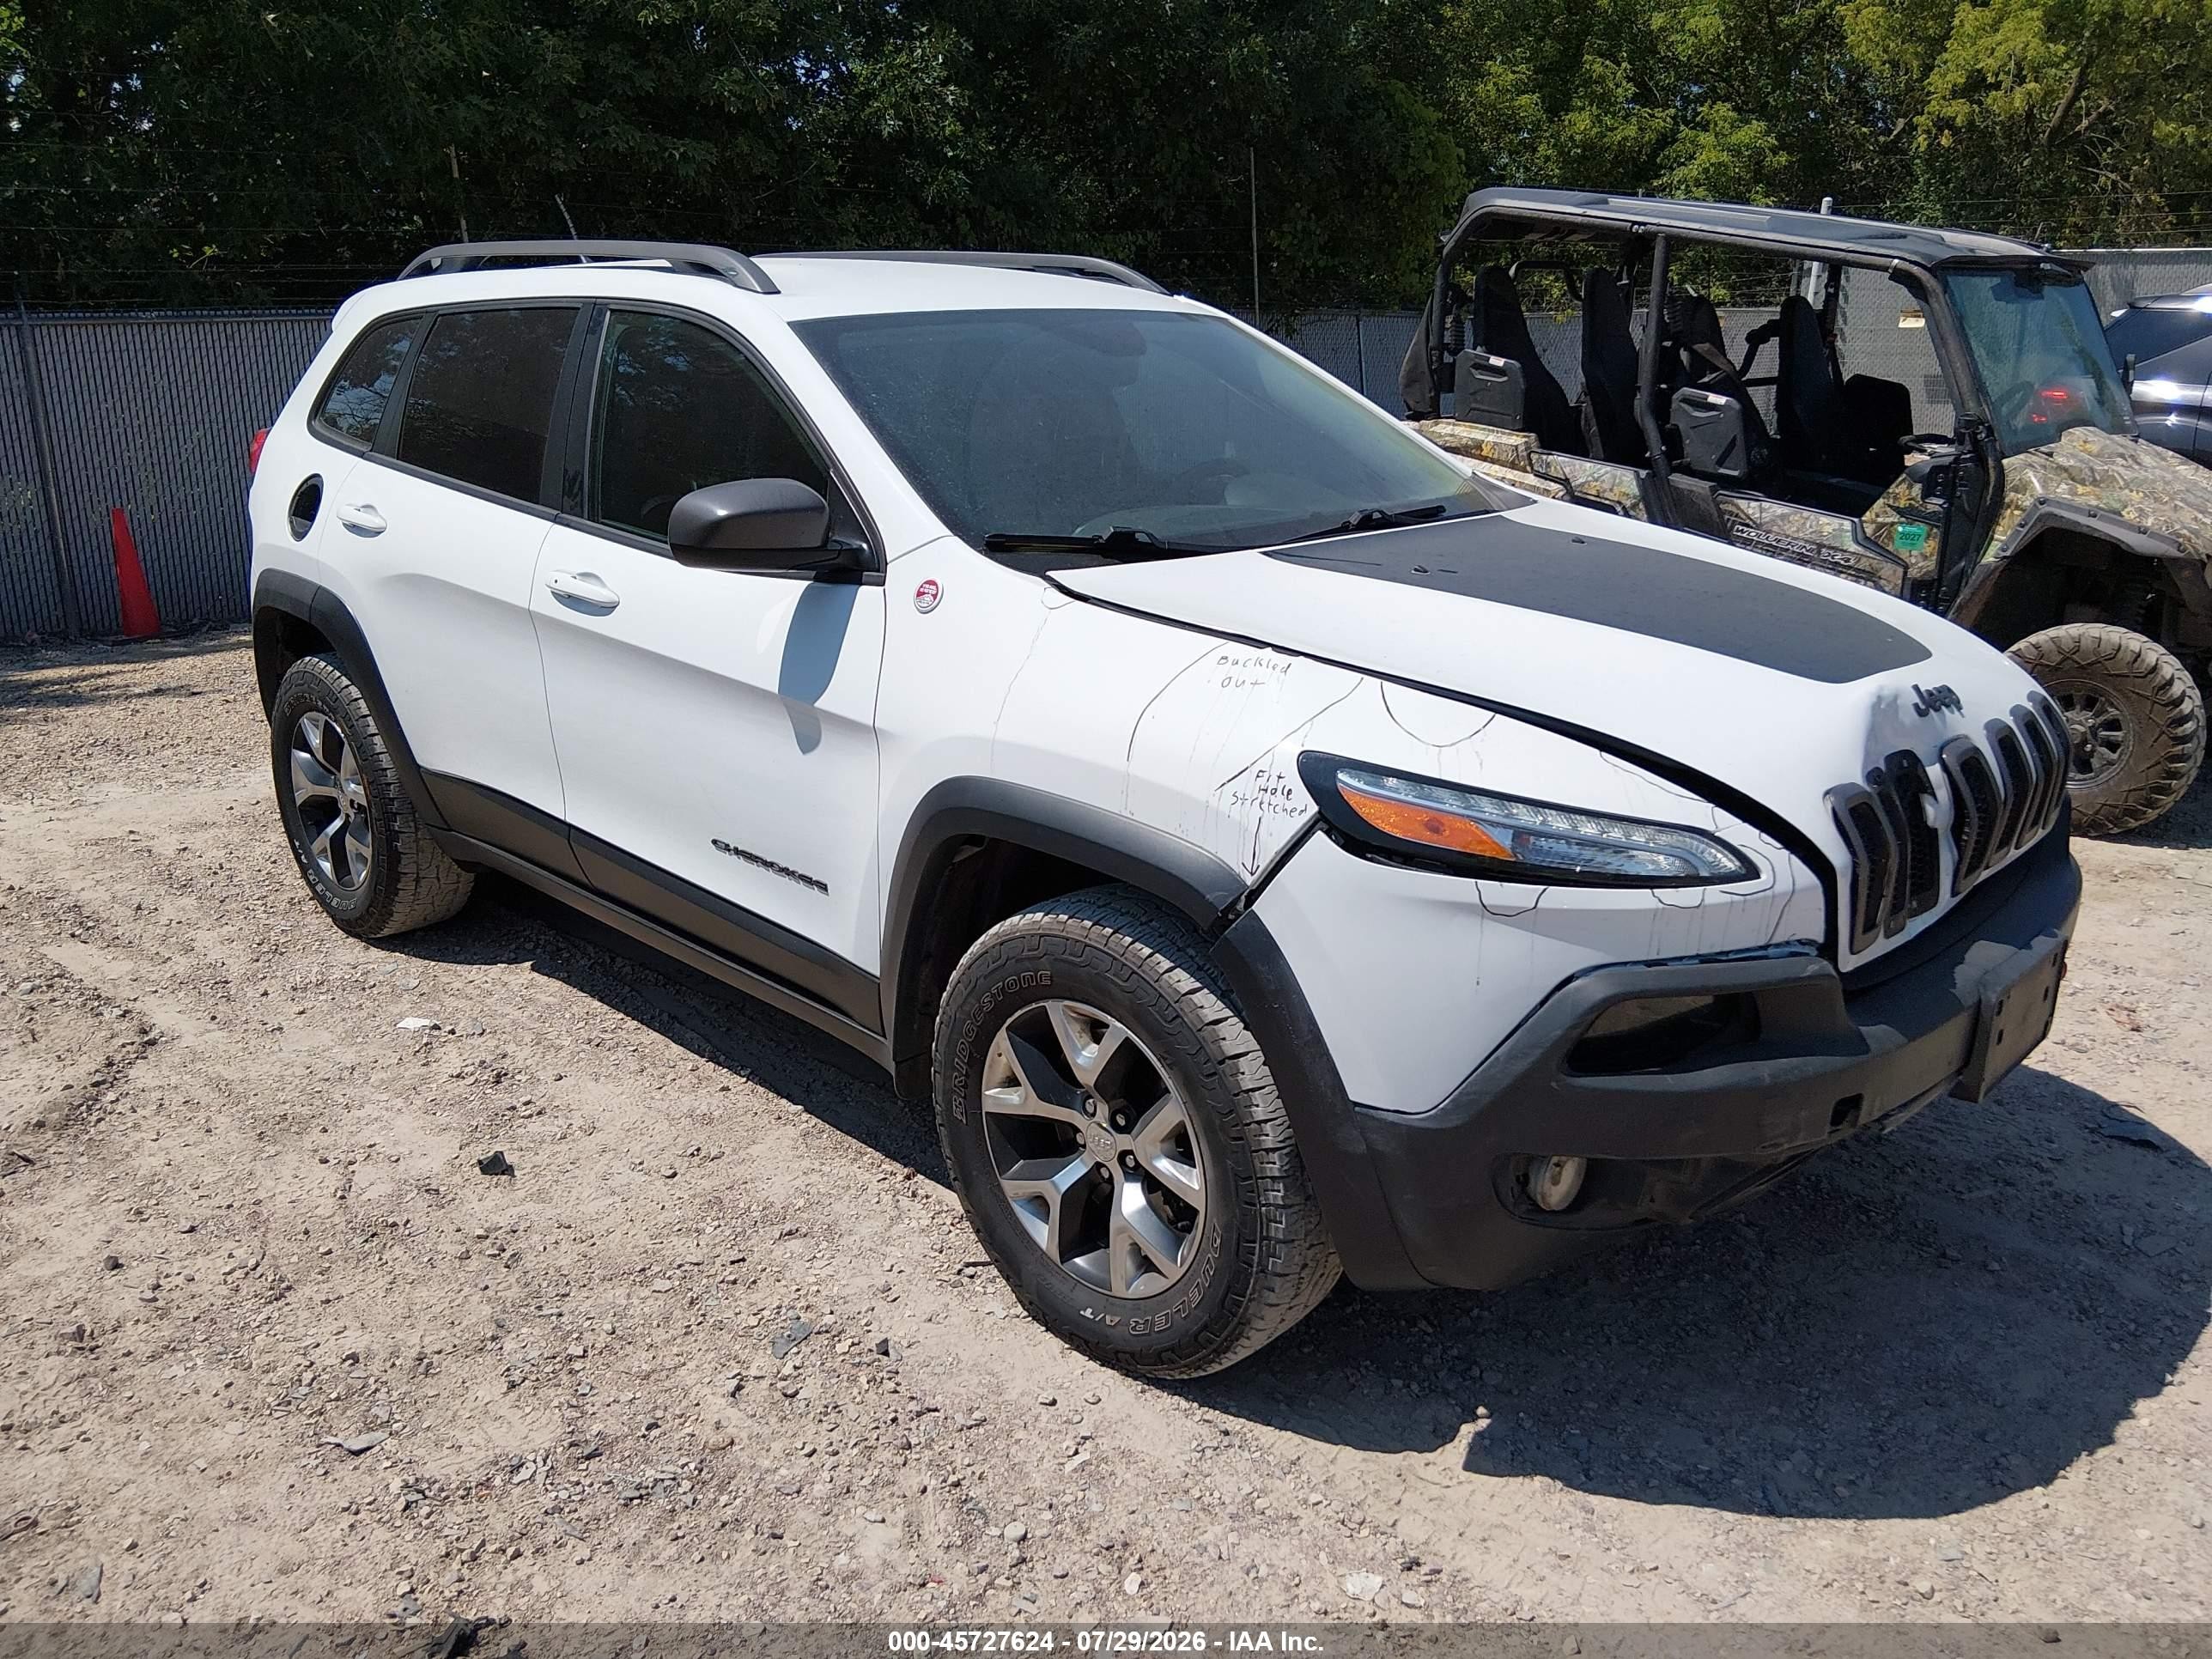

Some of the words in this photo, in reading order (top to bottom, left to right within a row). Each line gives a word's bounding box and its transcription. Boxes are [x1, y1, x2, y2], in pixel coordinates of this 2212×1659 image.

[1733, 525, 1815, 556] WOLVERIN
[1899, 532, 1922, 542] 2027
[1217, 655, 1292, 675] Buckled
[1911, 684, 1965, 719] Jeep
[1231, 790, 1308, 818] Stretched
[711, 838, 830, 896] CHEROKEE
[952, 971, 1052, 1125] BRIDGESTONE
[1128, 1223, 1222, 1335] DUELER
[1079, 1307, 1121, 1327] A/T
